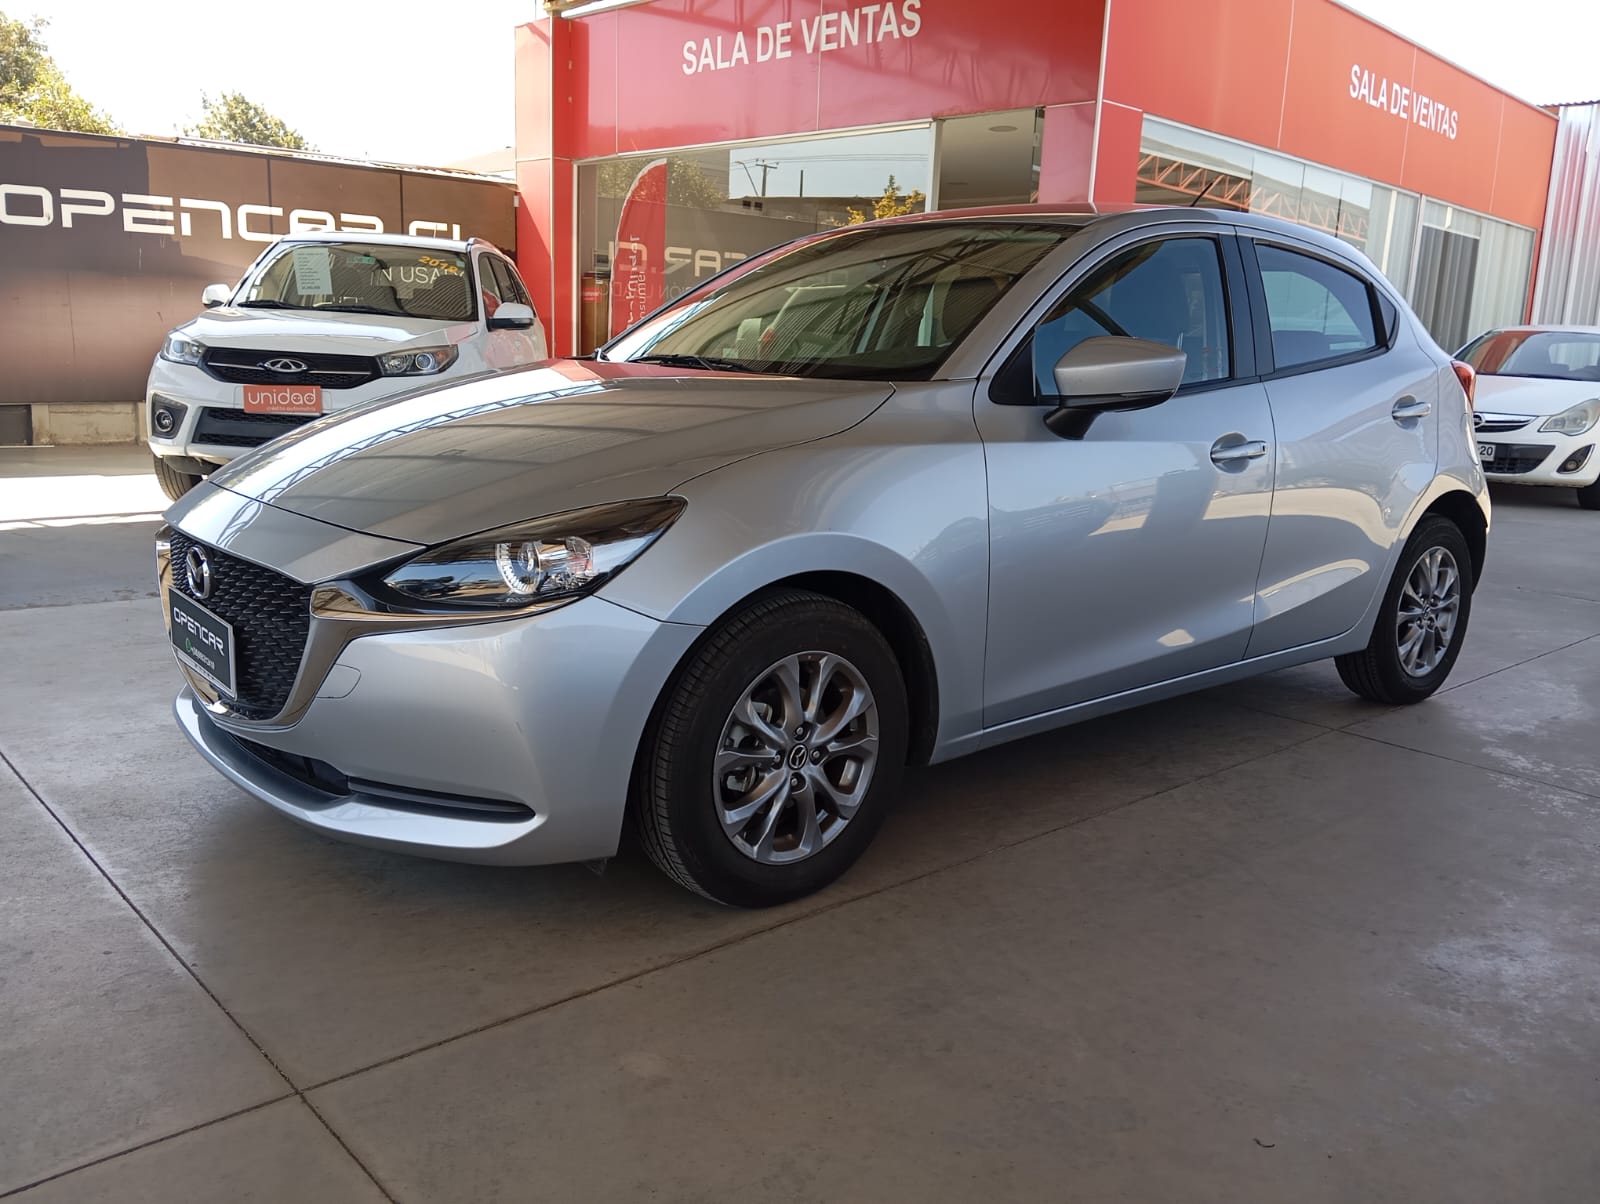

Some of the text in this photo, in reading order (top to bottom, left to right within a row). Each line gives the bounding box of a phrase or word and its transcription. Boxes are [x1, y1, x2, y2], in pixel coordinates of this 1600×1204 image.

[681, 0, 922, 76] SALA DE VENTAS
[1349, 64, 1459, 140] SALA DE VENTAS
[248, 388, 316, 404] unidad
[173, 606, 226, 657] OPENCAR
